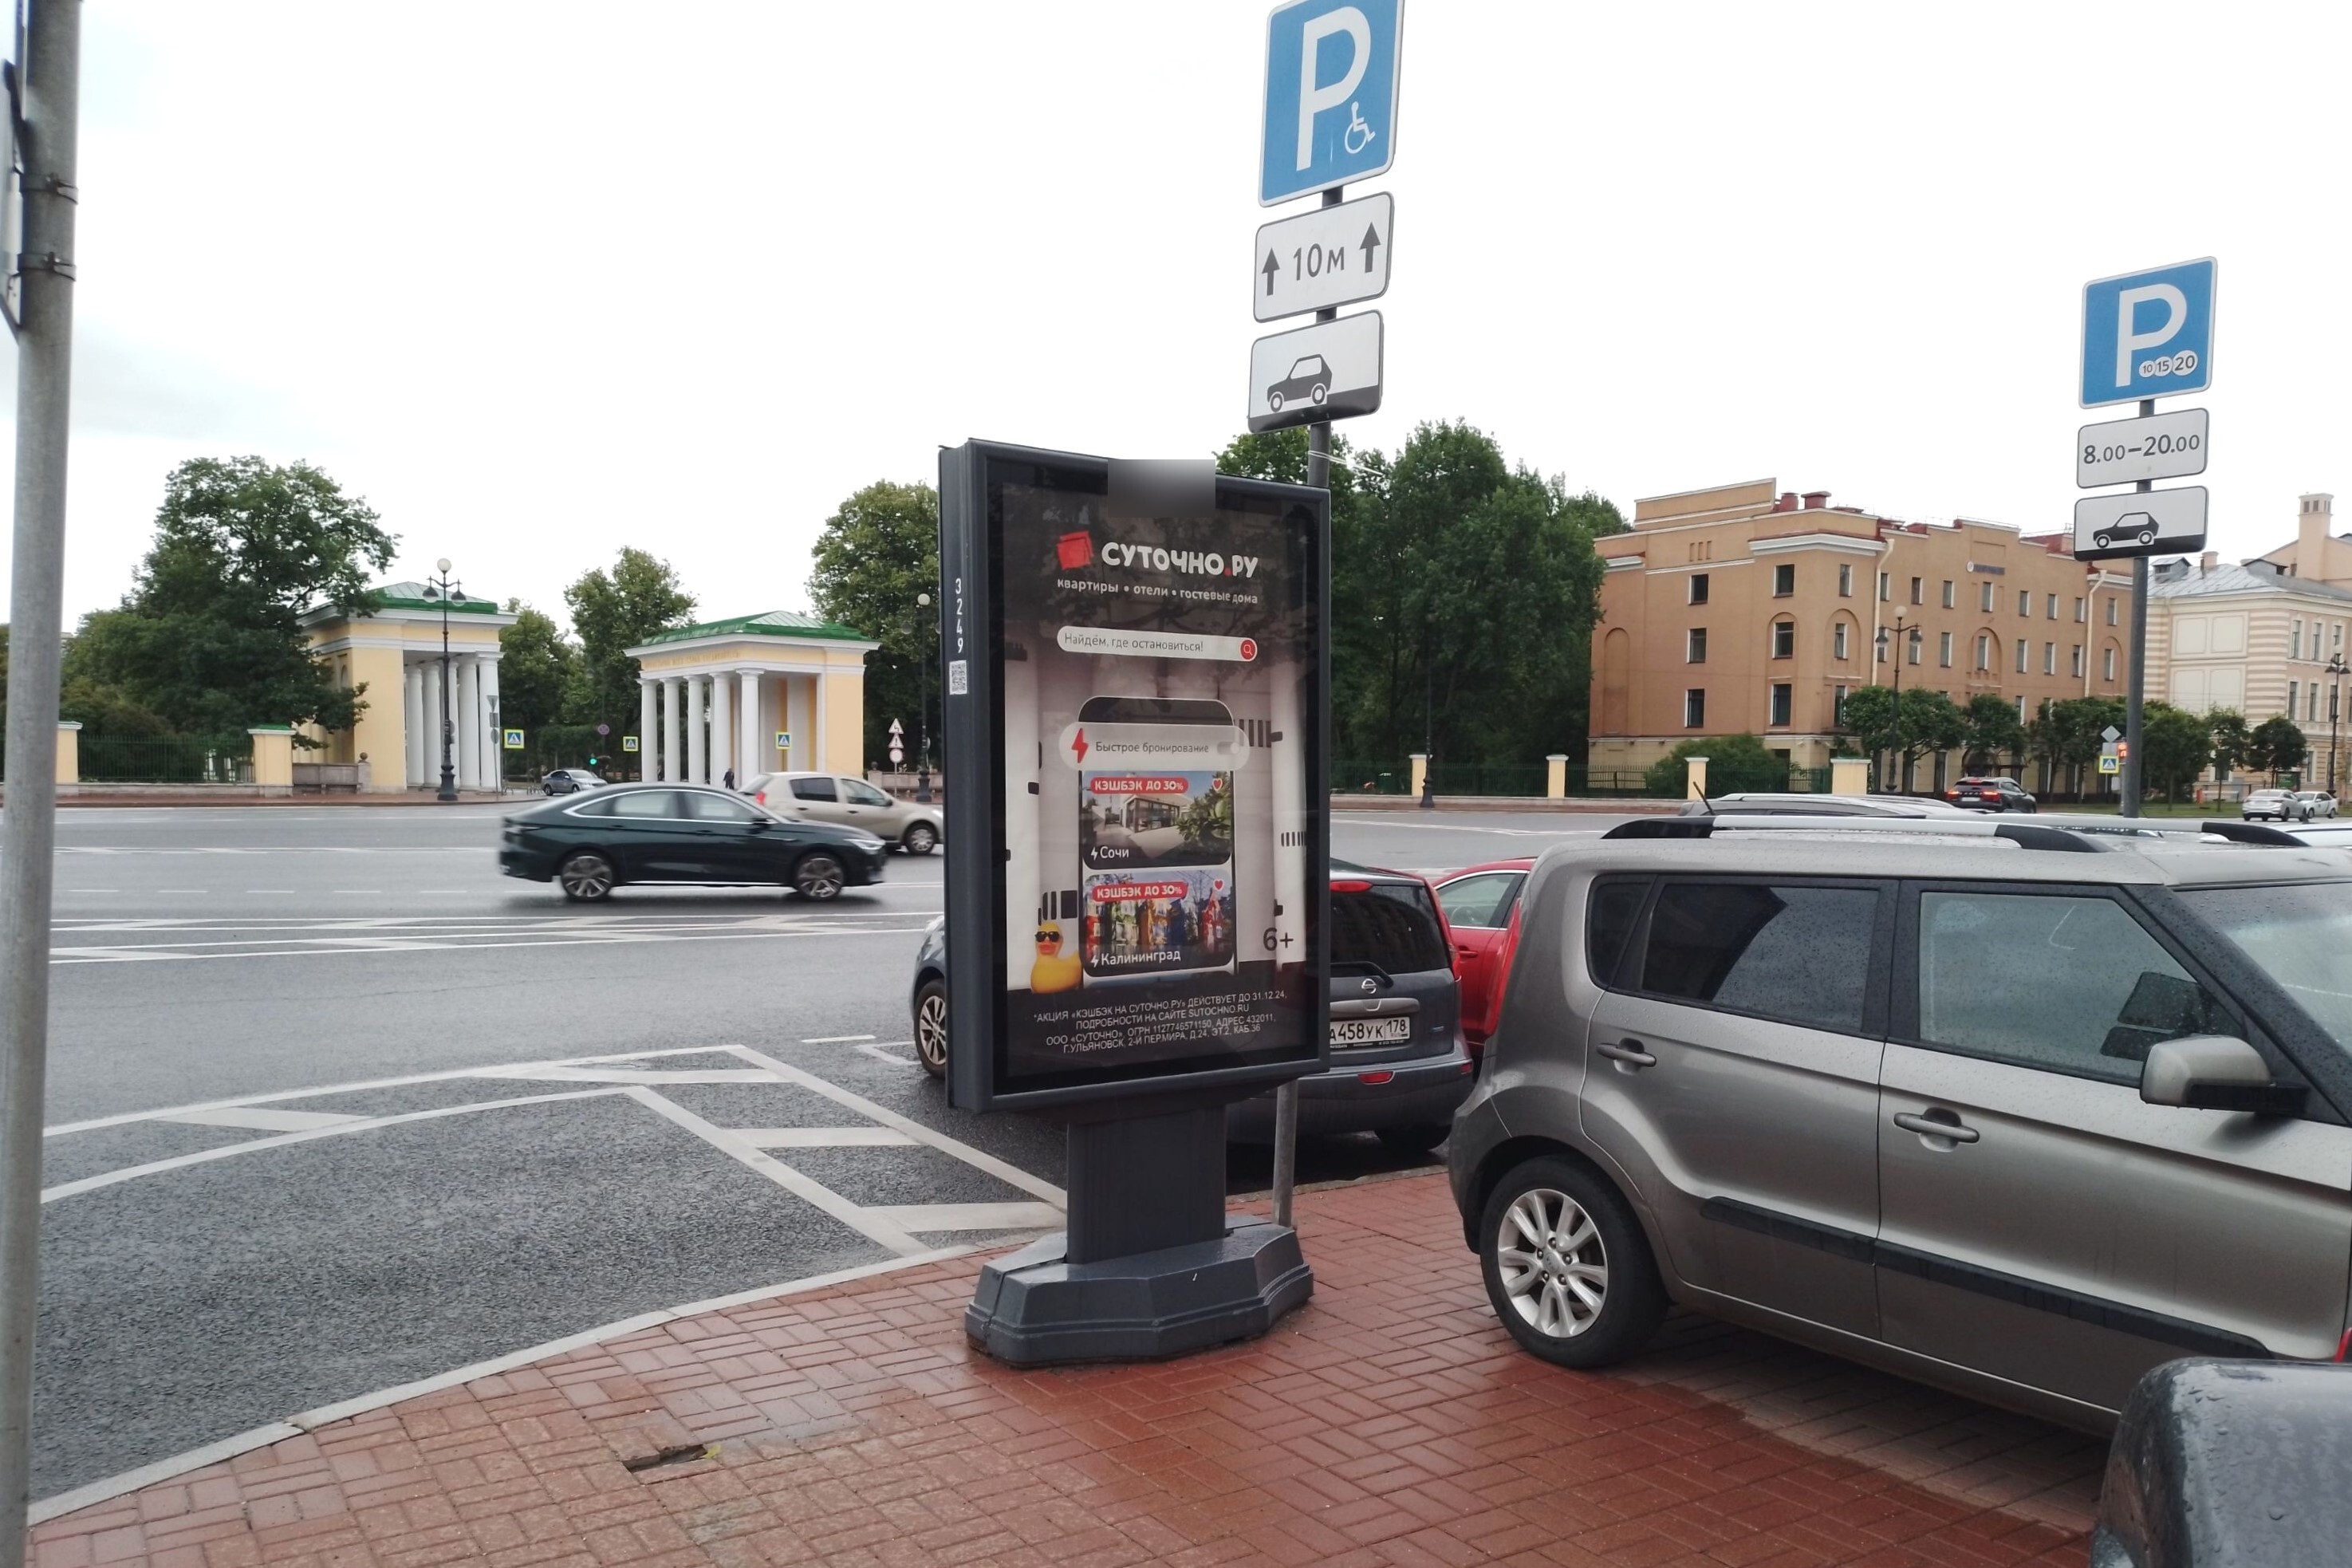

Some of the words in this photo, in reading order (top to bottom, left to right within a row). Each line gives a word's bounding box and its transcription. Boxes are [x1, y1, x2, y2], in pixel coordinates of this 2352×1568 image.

[2142, 364, 2153, 374] 10
[2157, 360, 2170, 373] 15
[2174, 354, 2196, 372] 20
[1101, 542, 1259, 578] СУТОЧНО.РУ
[1057, 577, 1119, 594] квартиры
[1133, 585, 1168, 597] отели
[1180, 589, 1231, 601] гостевые
[1231, 593, 1259, 605] дома
[1064, 632, 1109, 648] Найдём,
[1111, 638, 1129, 649] где
[1132, 639, 1204, 652] остановиться!
[1095, 741, 1140, 754] Быстрое
[1142, 742, 1209, 754] бронирование
[1094, 780, 1143, 790] КЭШБЭК
[1146, 781, 1161, 790] ДО
[1163, 780, 1184, 790] 30%
[1099, 845, 1129, 859] Сочи
[1097, 886, 1142, 899] КЭШБЭК
[1144, 885, 1160, 896] ДО
[1161, 884, 1183, 896] 30%
[1263, 927, 1294, 951] 6+
[1101, 949, 1181, 966] Калининград
[1114, 1004, 1127, 1014] НА
[1188, 994, 1237, 1008] ДЕЙСТВУЕТ
[1238, 992, 1251, 1003] ДО
[1076, 1014, 1143, 1030] ПОДРОБНОСТИ
[1144, 1012, 1157, 1022] НА
[1158, 1009, 1187, 1022] САЙТЕ
[1188, 1003, 1250, 1018] SUTOCHNO.RU
[1386, 1018, 1406, 1033] 178
[1046, 1034, 1068, 1046] ООО
[1127, 1026, 1151, 1037] ОГРН
[1215, 1015, 1245, 1027] АДРЕС
